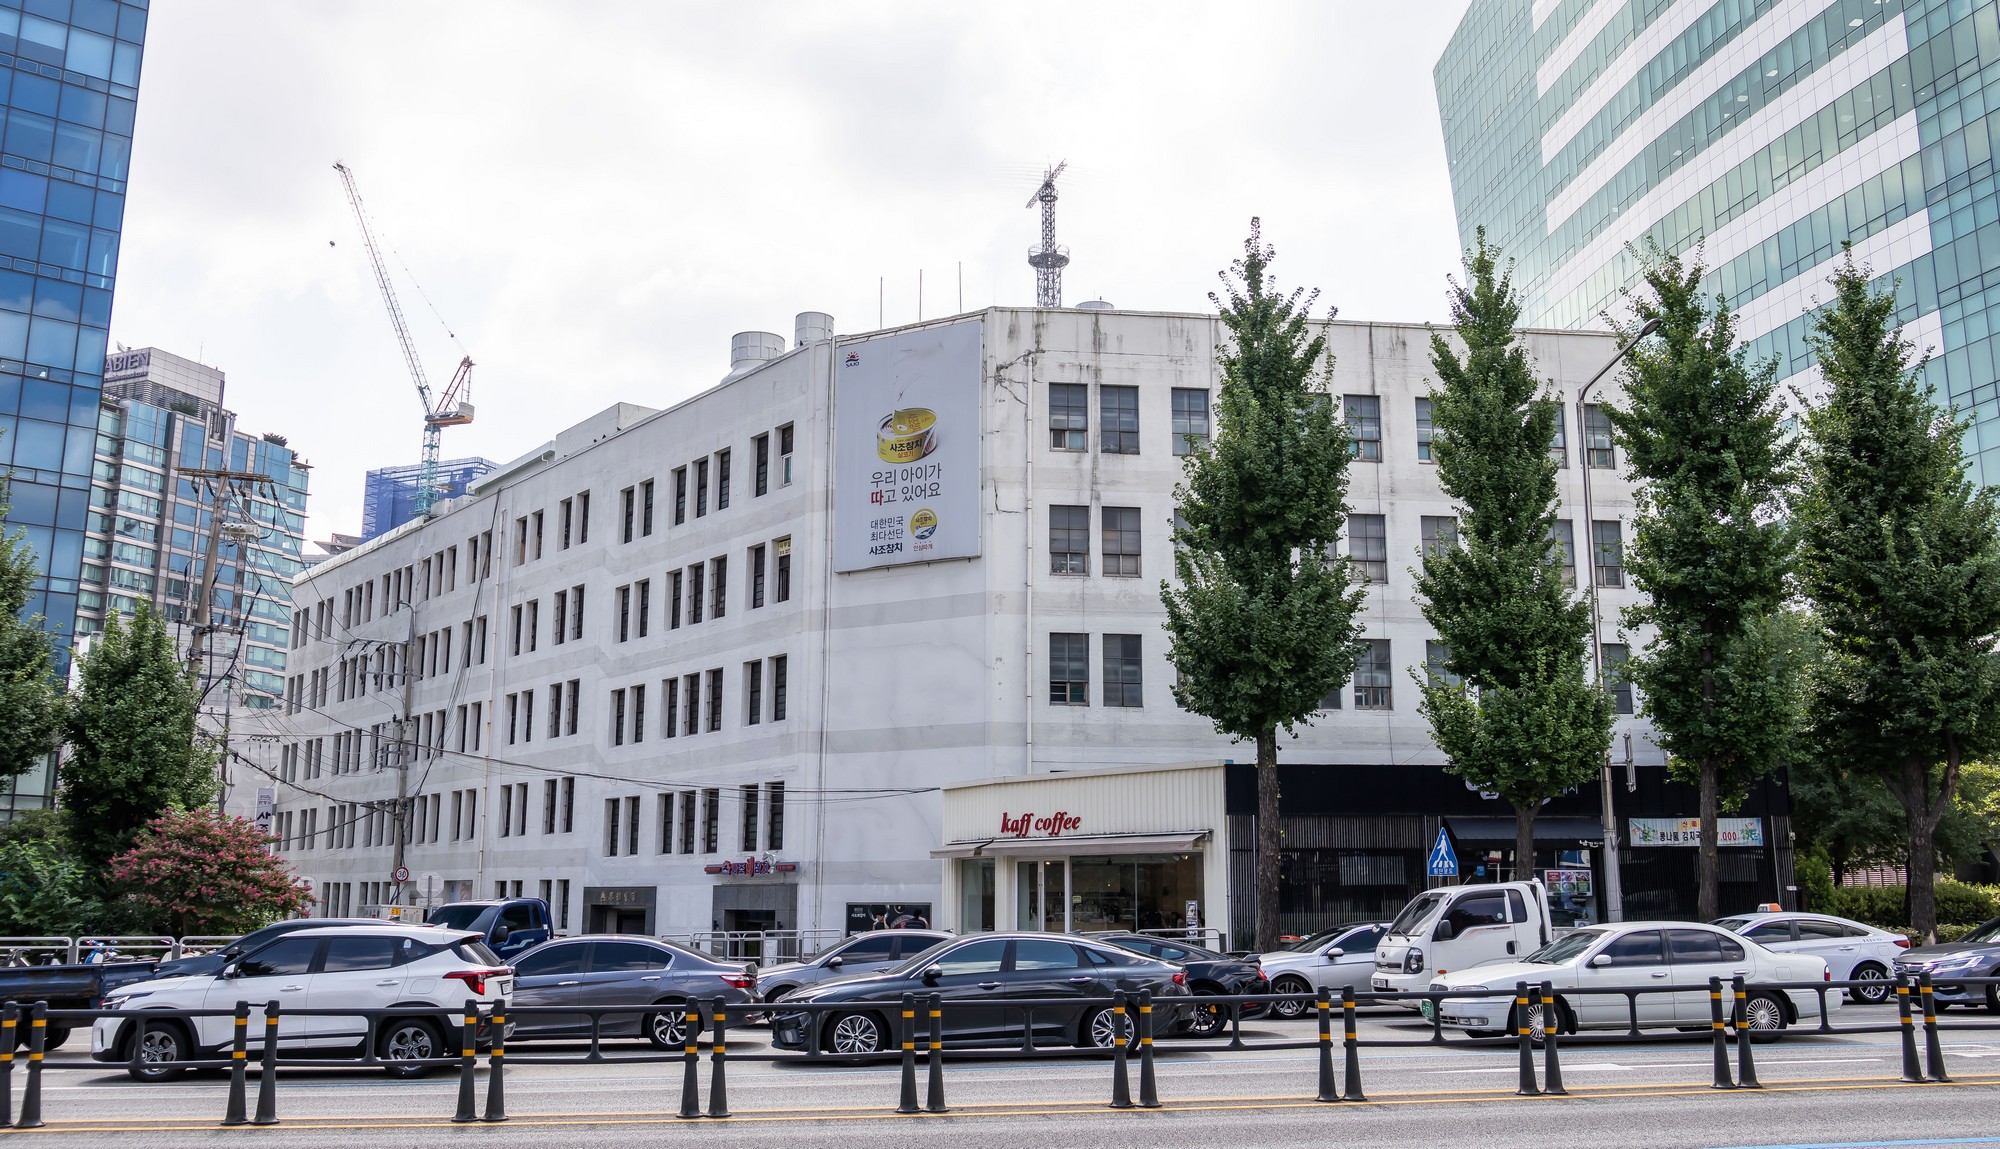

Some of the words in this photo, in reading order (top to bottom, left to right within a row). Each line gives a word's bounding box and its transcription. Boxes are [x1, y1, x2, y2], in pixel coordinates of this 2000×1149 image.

[890, 438, 923, 452] 사조참치
[870, 469, 897, 488] 우리
[901, 462, 942, 483] 아이가
[871, 489, 897, 506] 따고
[901, 482, 941, 502] 있어요
[870, 516, 904, 530] 대한민국
[870, 528, 904, 542] 최다선단
[869, 542, 903, 555] 사조참치
[1000, 812, 1034, 837] kaff
[1034, 811, 1081, 836] coffee
